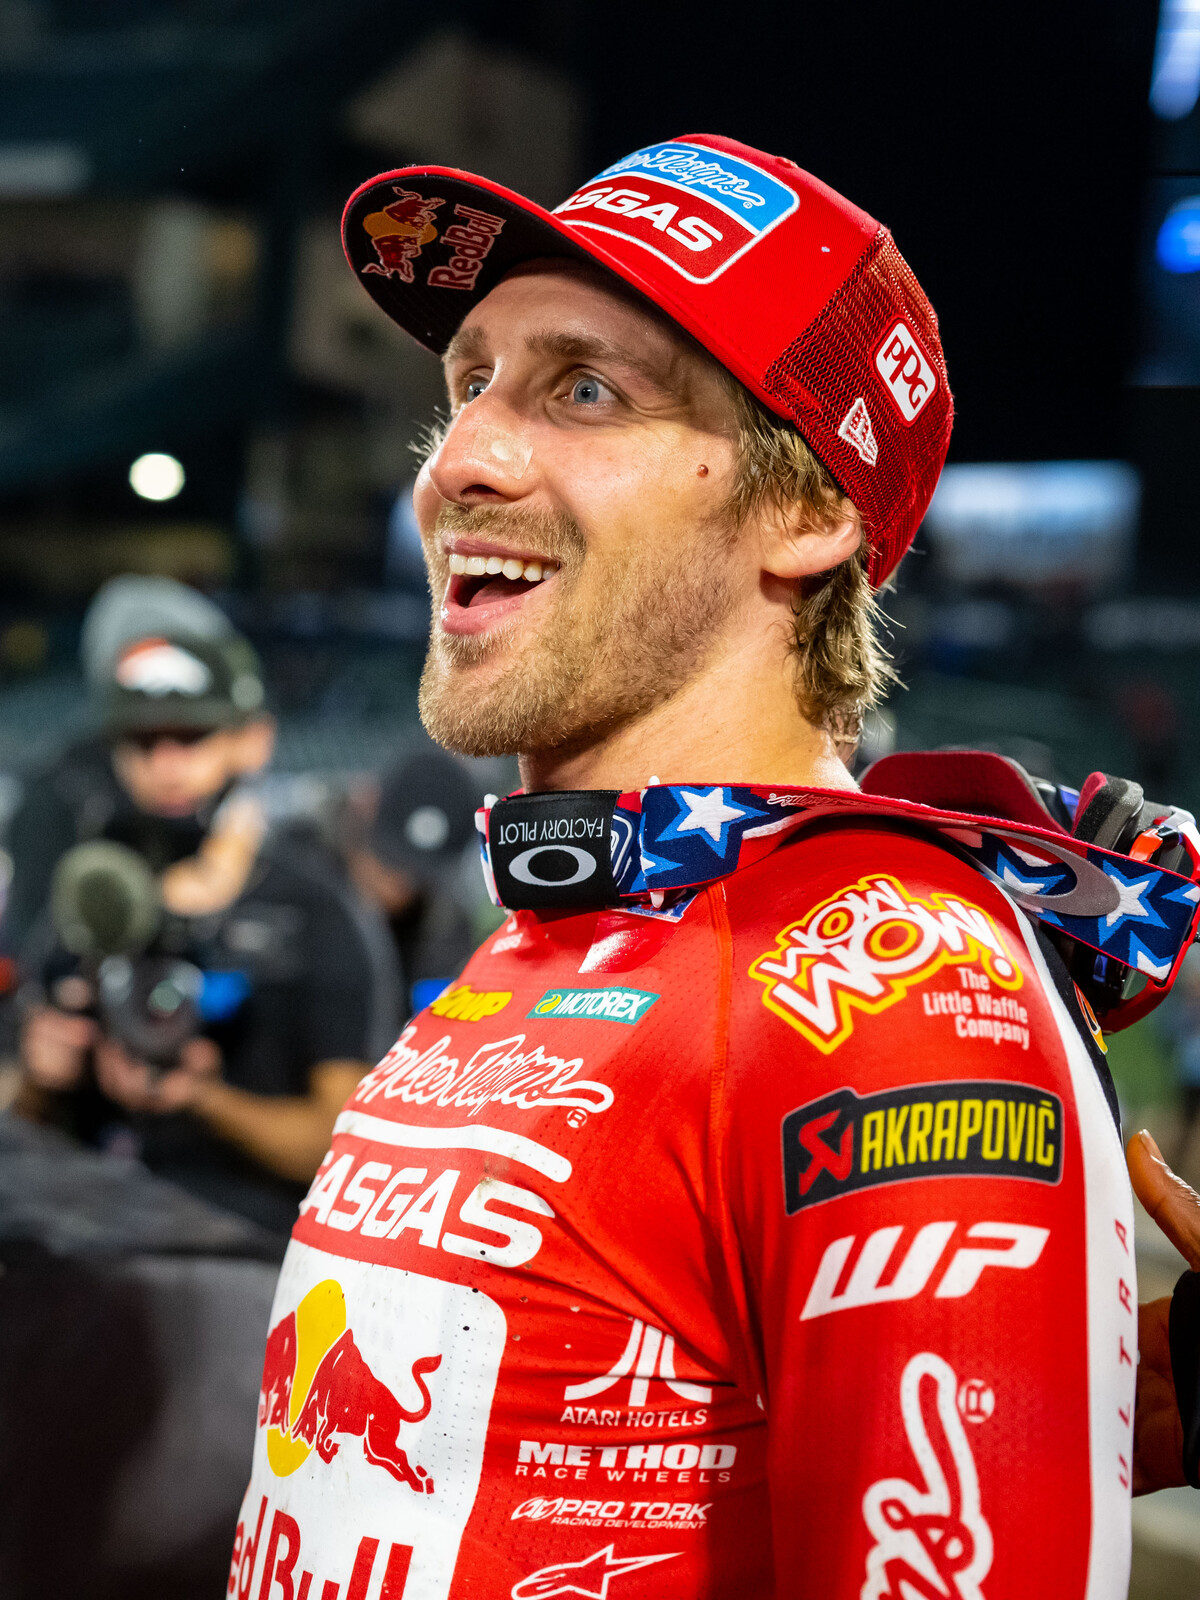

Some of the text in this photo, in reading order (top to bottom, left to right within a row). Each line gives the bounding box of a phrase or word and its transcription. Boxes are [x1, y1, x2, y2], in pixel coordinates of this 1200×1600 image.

[883, 334, 929, 411] PPG
[498, 817, 604, 846] FACTORY PILOT
[759, 880, 907, 979] WOW
[957, 966, 990, 992] The
[553, 991, 652, 1020] MOTOREX
[922, 991, 1029, 1024] Little Waffle
[955, 1014, 1030, 1050] Company
[298, 1150, 556, 1268] ASGAS
[799, 1220, 1050, 1322] WP
[1113, 1219, 1133, 1490] ULTRA
[560, 1406, 708, 1428] ATARI HOTELS
[517, 1439, 737, 1469] METHOD
[514, 1465, 732, 1483] RACE WHEELS
[551, 1516, 707, 1530] RACING DEVELOPMENT
[558, 1499, 714, 1521] PRO TORK
